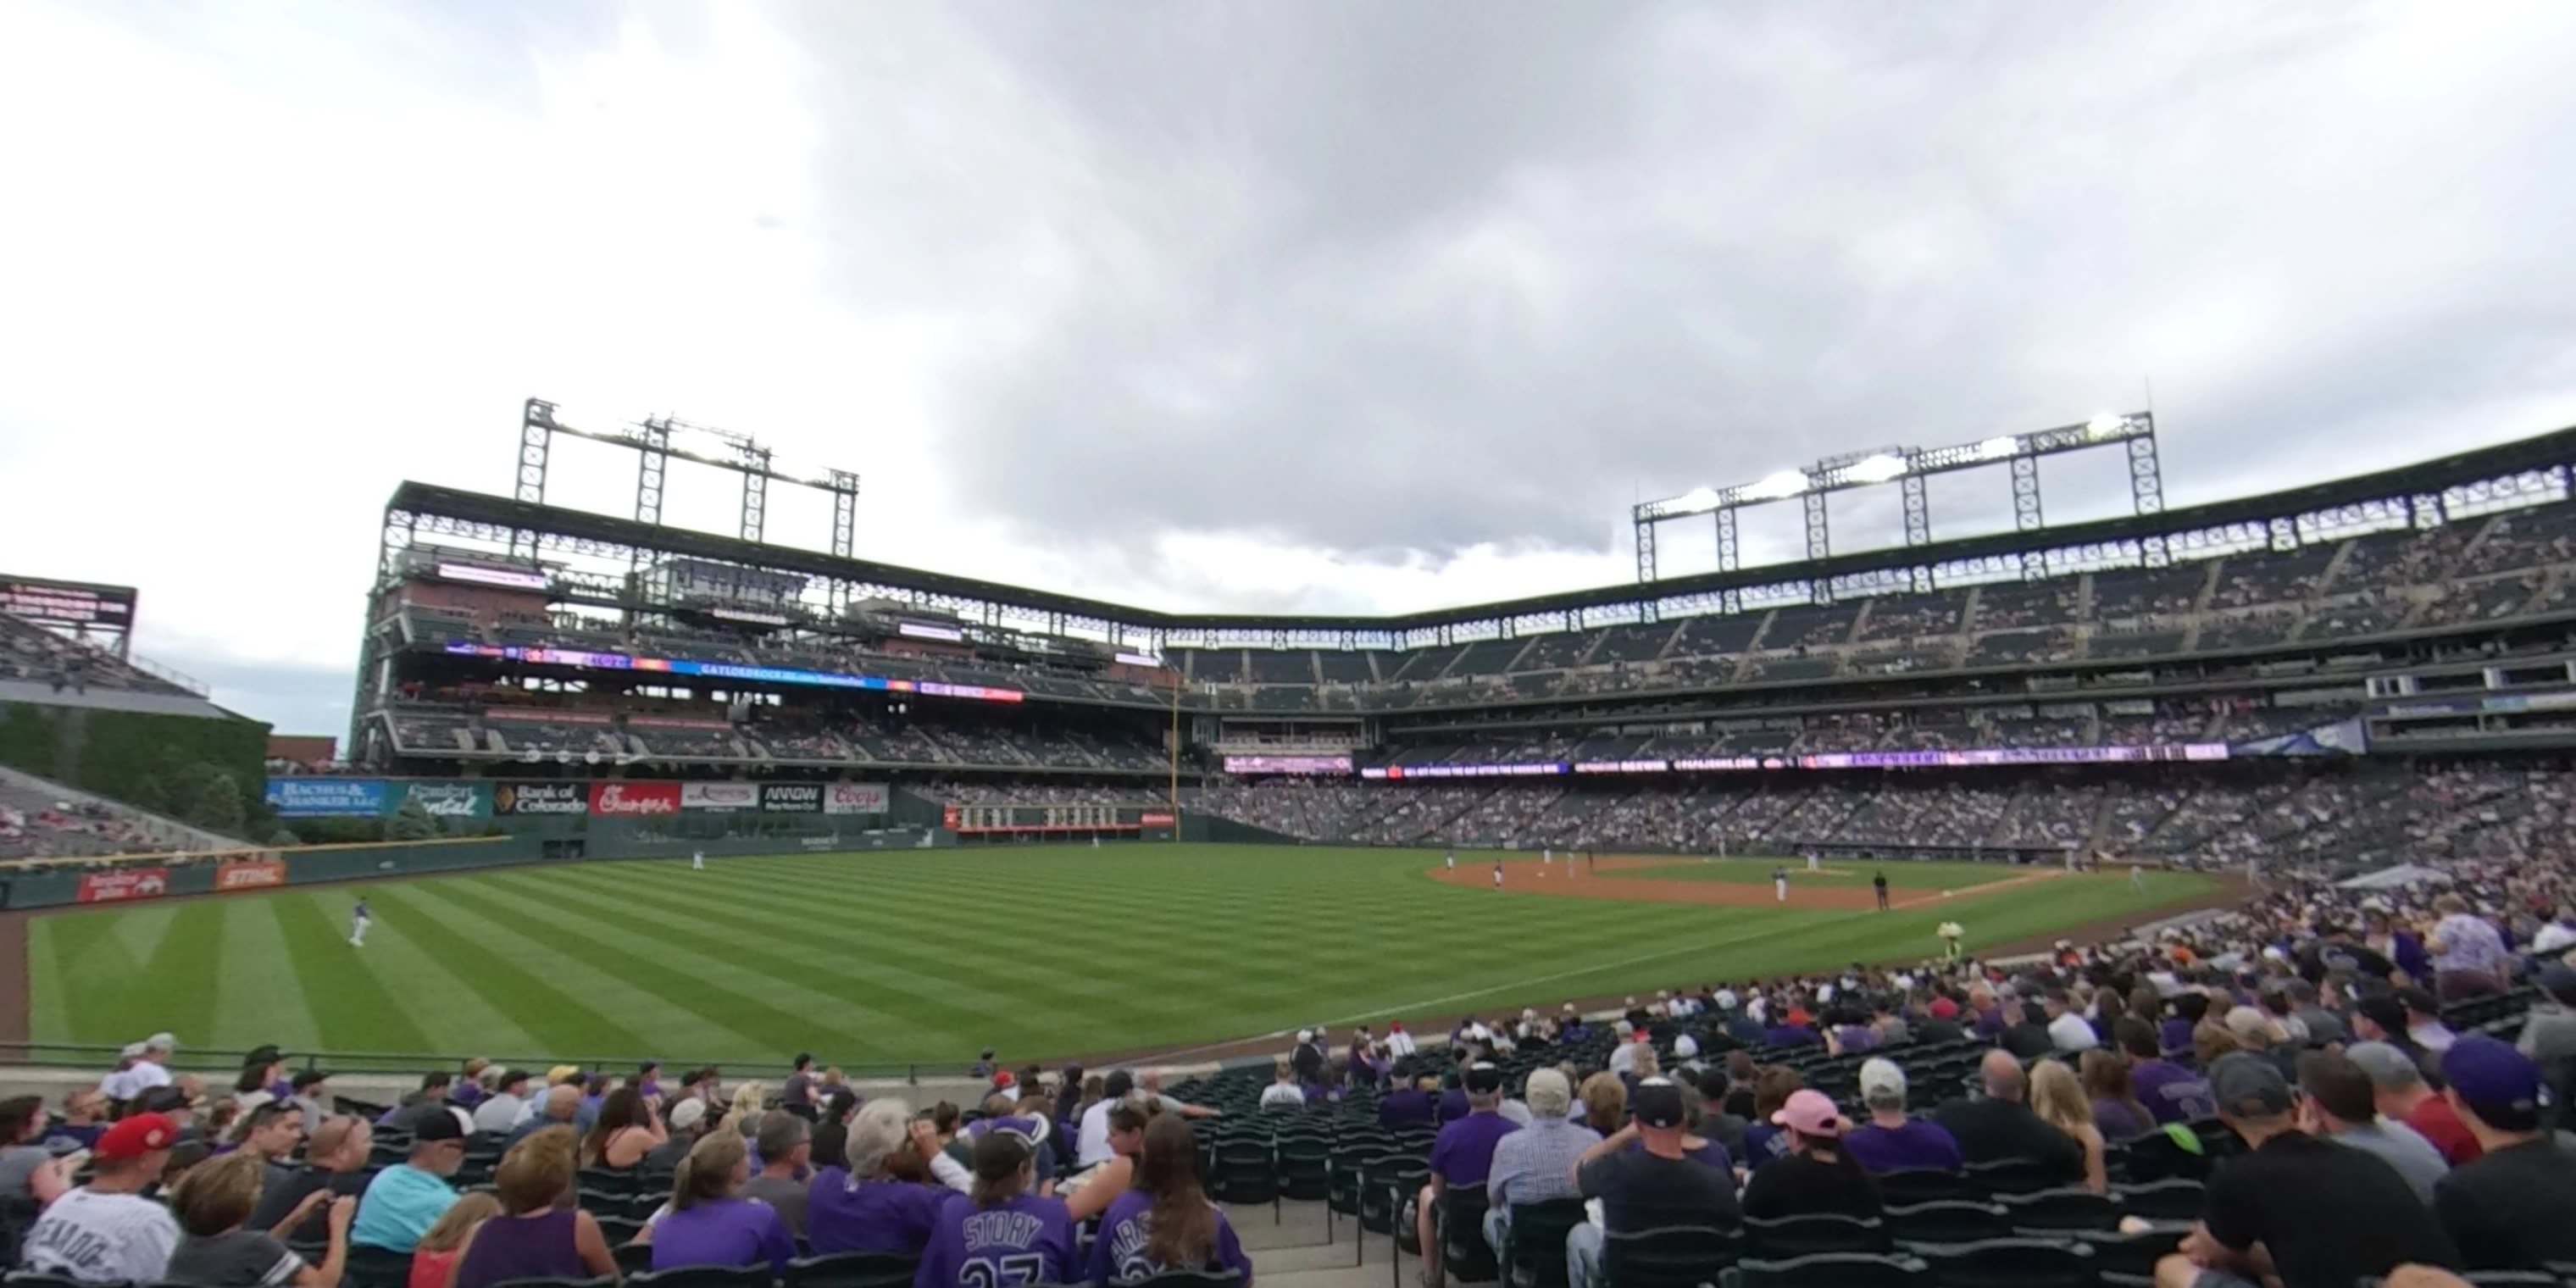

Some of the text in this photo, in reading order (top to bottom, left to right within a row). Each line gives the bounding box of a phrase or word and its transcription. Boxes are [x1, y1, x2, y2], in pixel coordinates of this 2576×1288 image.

[517, 785, 576, 798] Bank of
[764, 786, 819, 801] ARROW
[835, 786, 880, 804] Coors
[516, 798, 587, 813] Colorado
[224, 868, 280, 886] STIHL
[963, 1212, 1043, 1251] STORY
